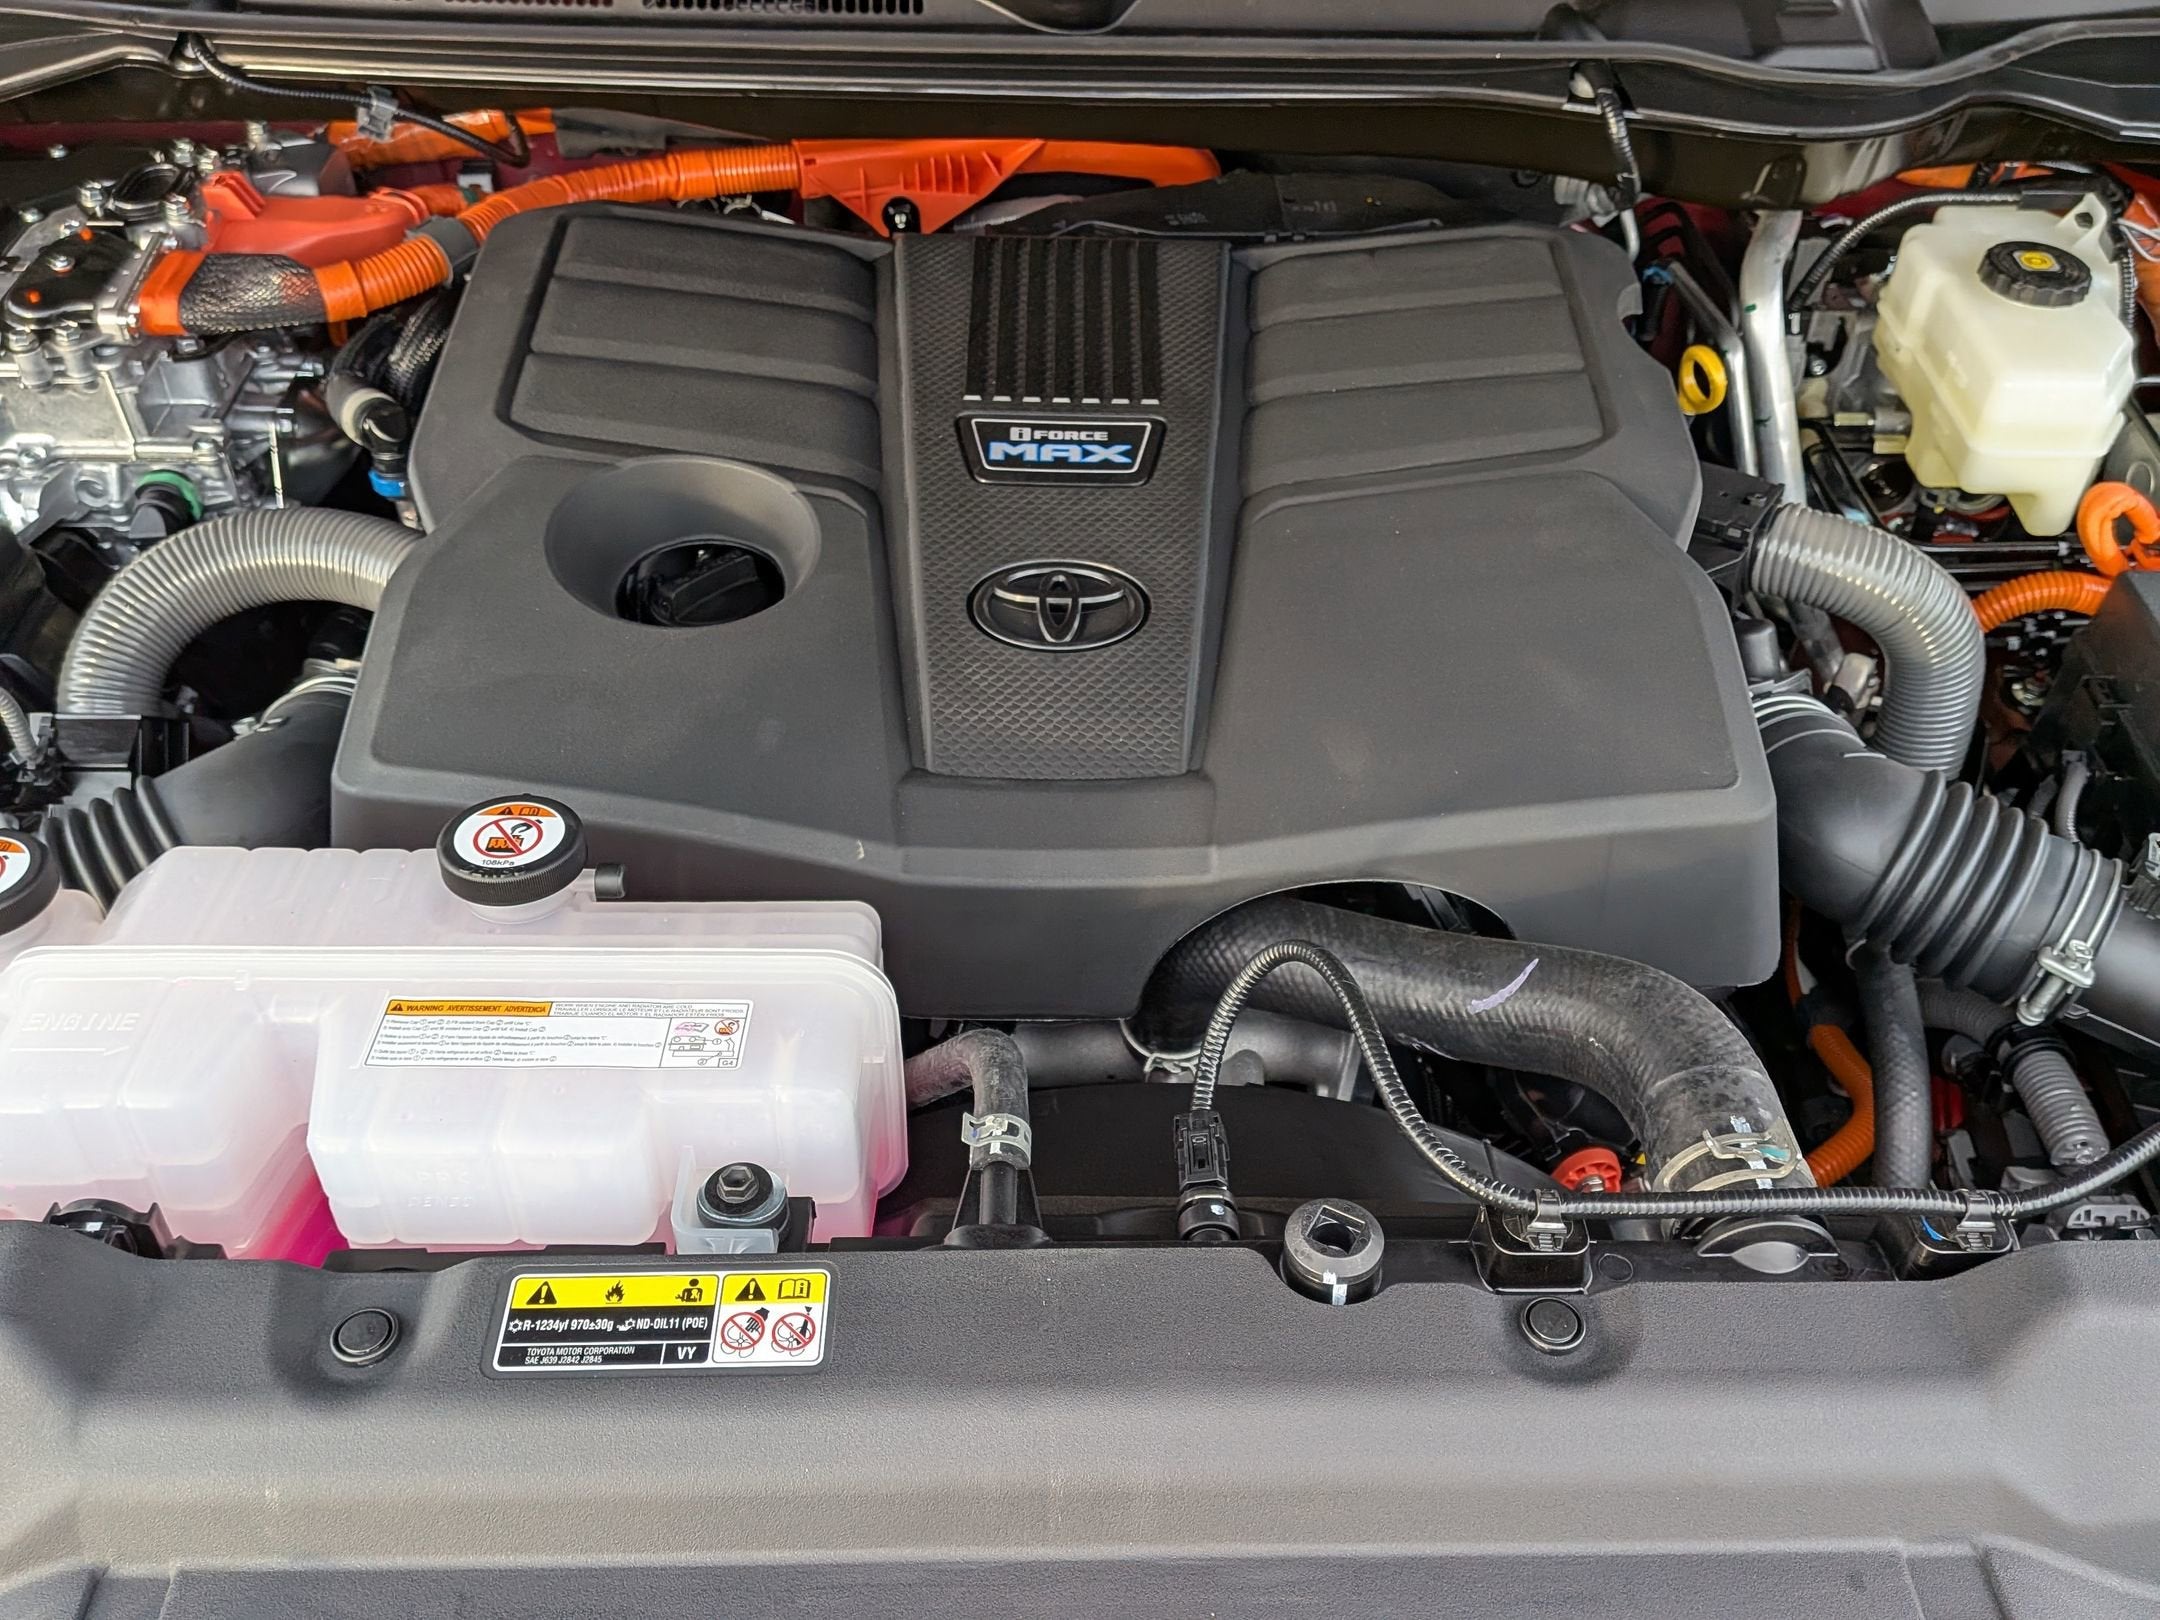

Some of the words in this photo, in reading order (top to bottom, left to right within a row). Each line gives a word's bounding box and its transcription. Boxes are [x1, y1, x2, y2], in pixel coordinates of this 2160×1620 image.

[988, 441, 1133, 464] MAX
[22, 1012, 141, 1031] ENGINE
[522, 1318, 568, 1332] R-1234yf
[570, 1318, 614, 1332] 970±30g
[636, 1317, 679, 1330] ND-OIL11
[682, 1317, 708, 1331] (POE)
[527, 1347, 554, 1356] TOYOTA
[555, 1347, 582, 1355] MOTOR
[583, 1346, 635, 1355] CORPORATION
[677, 1347, 697, 1360] VY
[525, 1356, 540, 1365] SAE
[541, 1356, 558, 1364] J639
[558, 1356, 580, 1364] J2842
[581, 1355, 602, 1364] J2845
